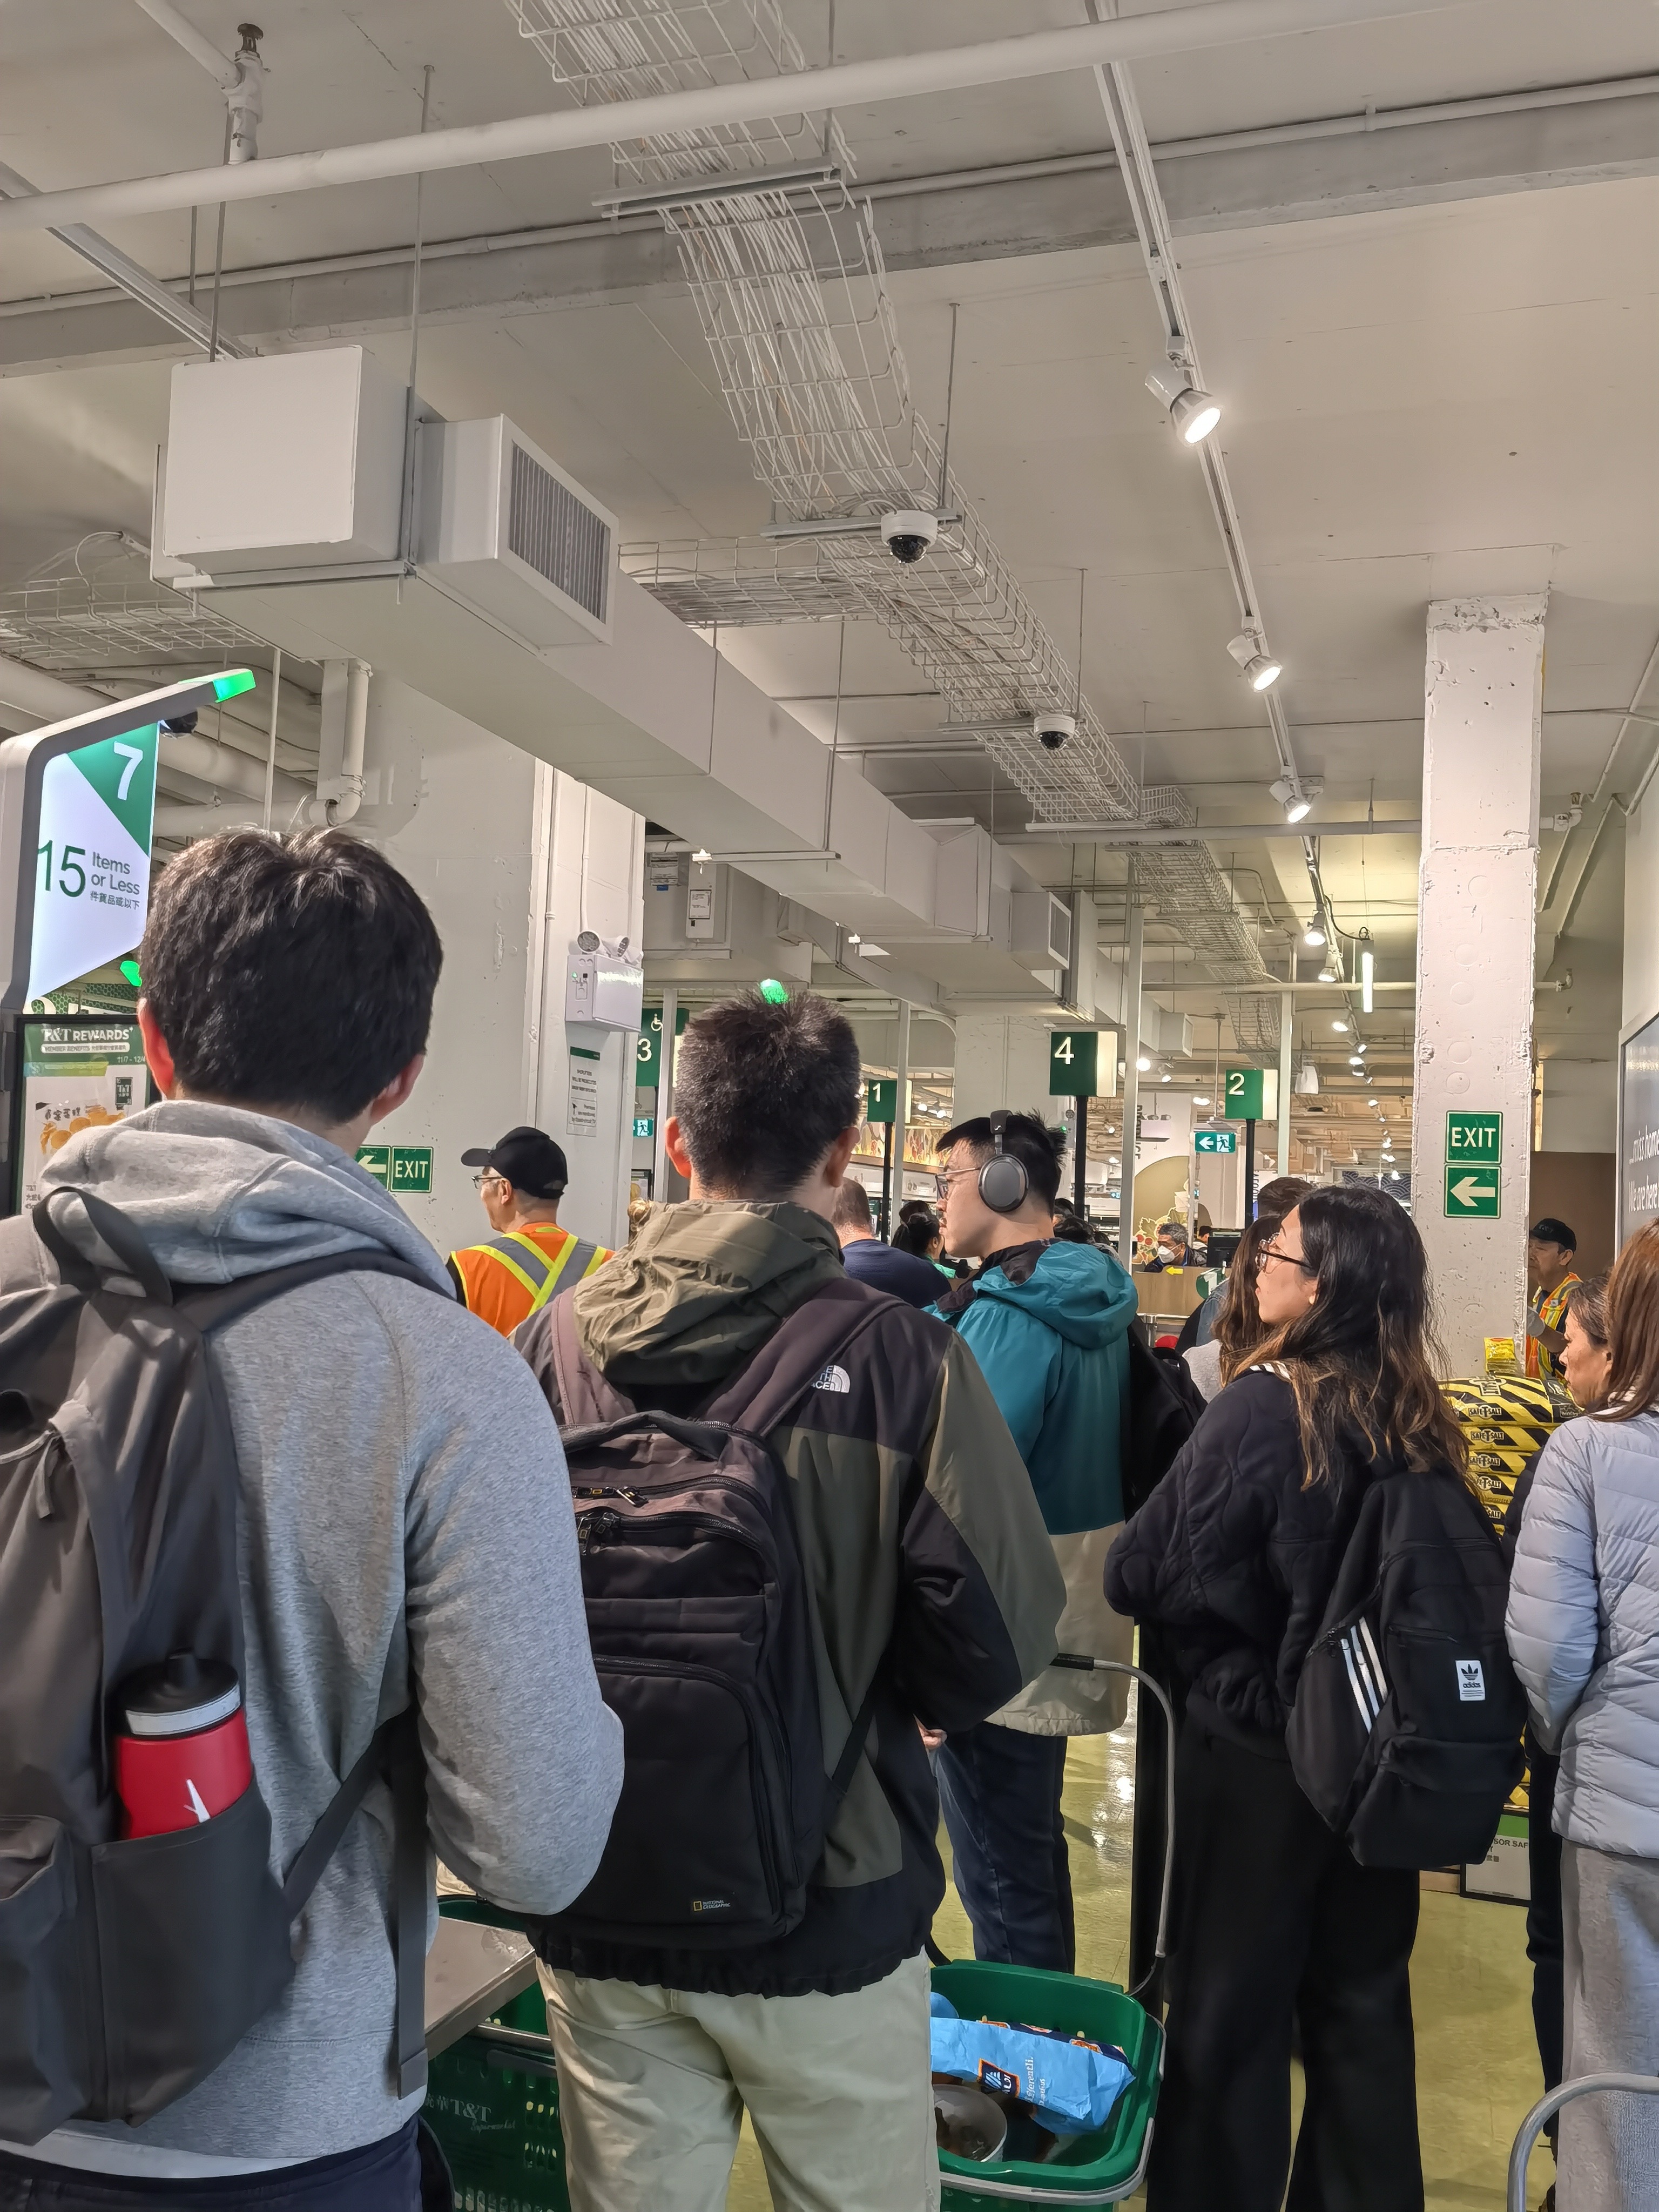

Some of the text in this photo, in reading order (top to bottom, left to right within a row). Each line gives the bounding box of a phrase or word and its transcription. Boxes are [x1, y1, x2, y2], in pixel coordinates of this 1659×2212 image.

[114, 741, 143, 801] 7
[38, 840, 86, 898] 15
[92, 852, 131, 874] Items
[91, 874, 140, 895] or Less
[72, 1029, 130, 1041] REWARDS
[637, 1038, 652, 1062] 3
[1054, 1036, 1075, 1065] 4
[873, 1082, 881, 1102] 1
[1229, 1073, 1245, 1095] 2
[1451, 1127, 1496, 1148] EXIT
[395, 1161, 429, 1178] EXIT
[1629, 1175, 1658, 1213] We are here
[450, 2099, 492, 2123] T&T
